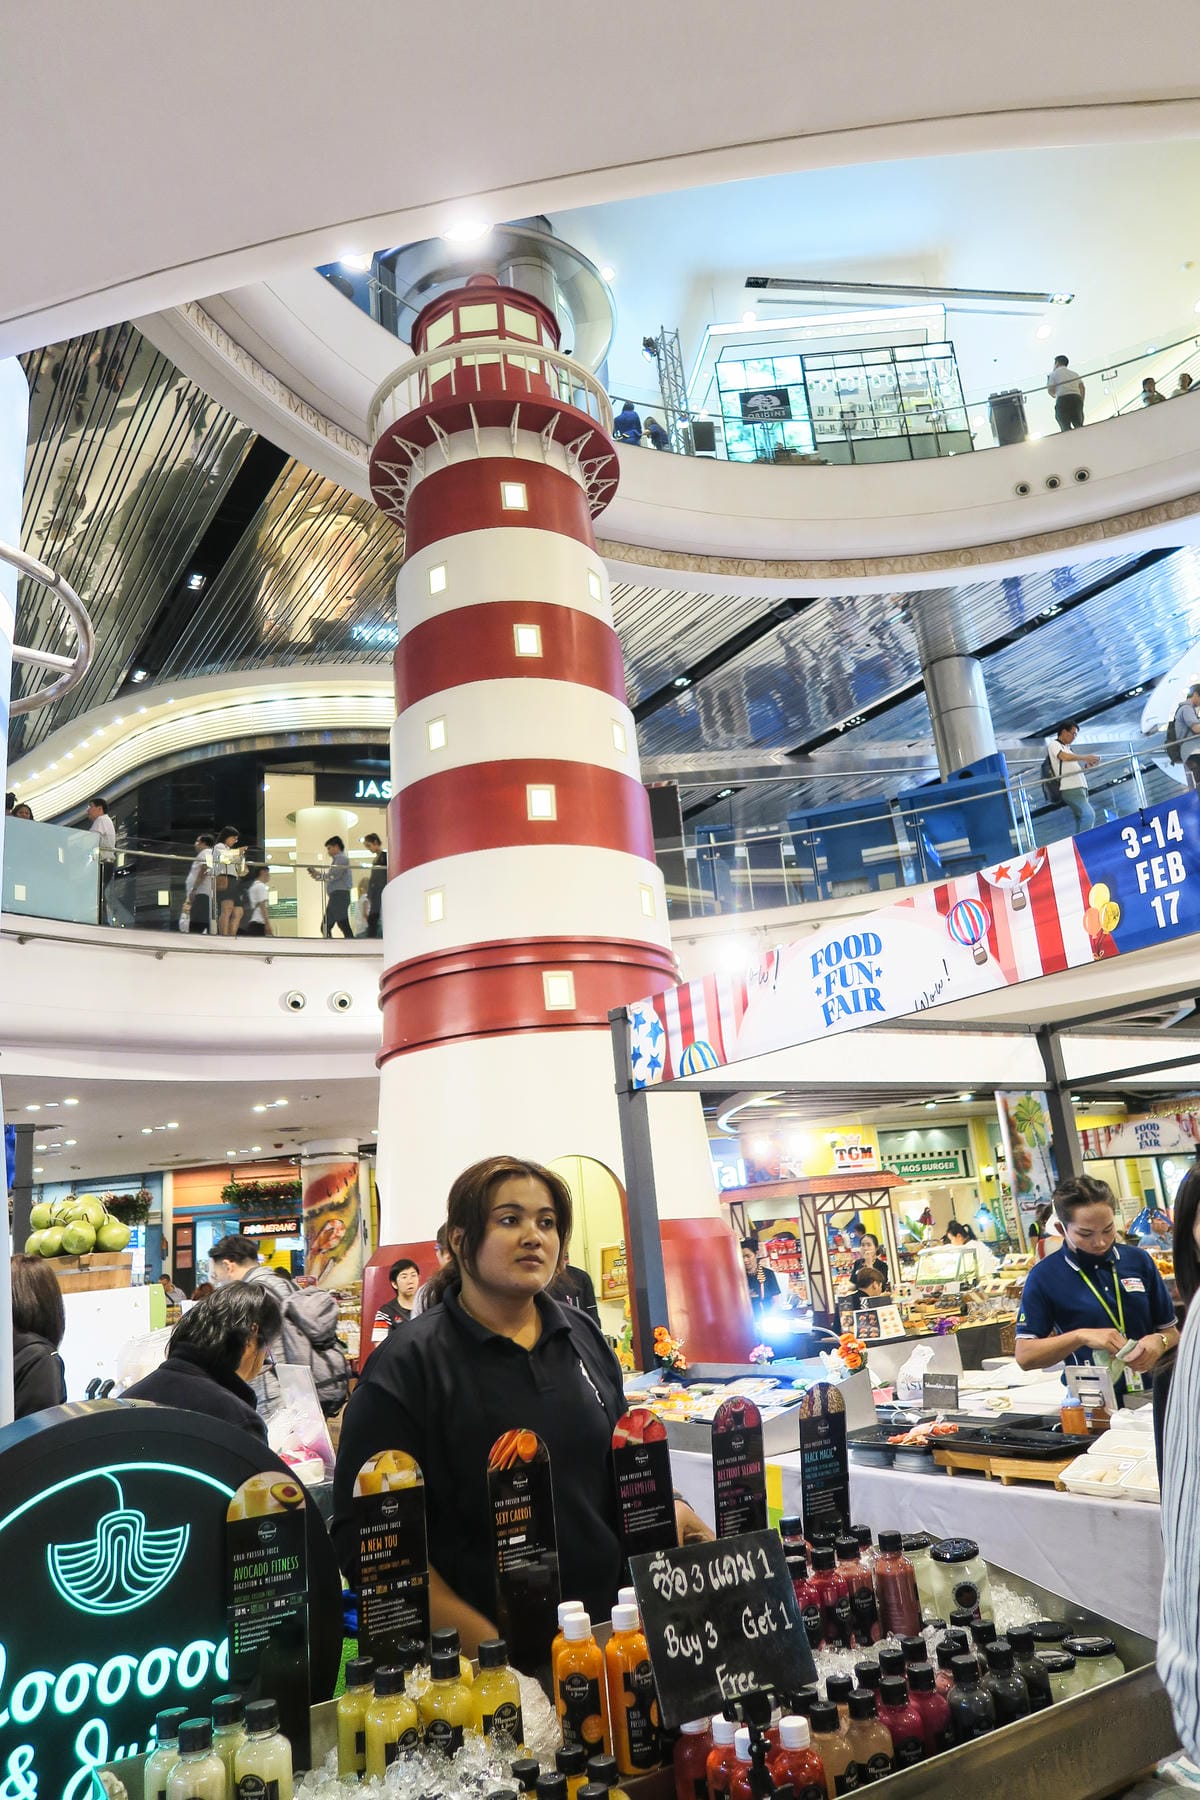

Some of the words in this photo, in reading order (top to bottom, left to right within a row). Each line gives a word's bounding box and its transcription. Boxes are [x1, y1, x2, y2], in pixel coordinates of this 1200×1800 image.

[1121, 809, 1184, 859] 3-14
[1135, 851, 1186, 894] FEB
[1150, 890, 1180, 929] 17
[809, 932, 882, 979] FOOD
[824, 961, 873, 999] FUN
[821, 987, 886, 1028] FAIR
[1134, 1122, 1160, 1134] FOOD
[1138, 1139, 1160, 1150] FAIR
[1139, 1131, 1158, 1141] FUN
[835, 1146, 873, 1161] TGM
[901, 1163, 921, 1173] MOS
[922, 1161, 955, 1172] BURGER
[496, 1511, 509, 1526] SEXY
[510, 1506, 532, 1522] CARROT
[367, 1537, 383, 1552] NEW
[384, 1534, 398, 1549] YOU
[233, 1562, 269, 1581] AVOCADO
[271, 1555, 299, 1574] FITNESS
[649, 1551, 688, 1600] ซื้อ
[690, 1564, 705, 1593] 3
[708, 1550, 756, 1591] แถม
[757, 1548, 775, 1579] 1
[664, 1624, 703, 1665] Buy
[705, 1621, 718, 1649] 3
[742, 1601, 777, 1639] Get
[779, 1601, 793, 1630] 1
[715, 1663, 759, 1700] Free
